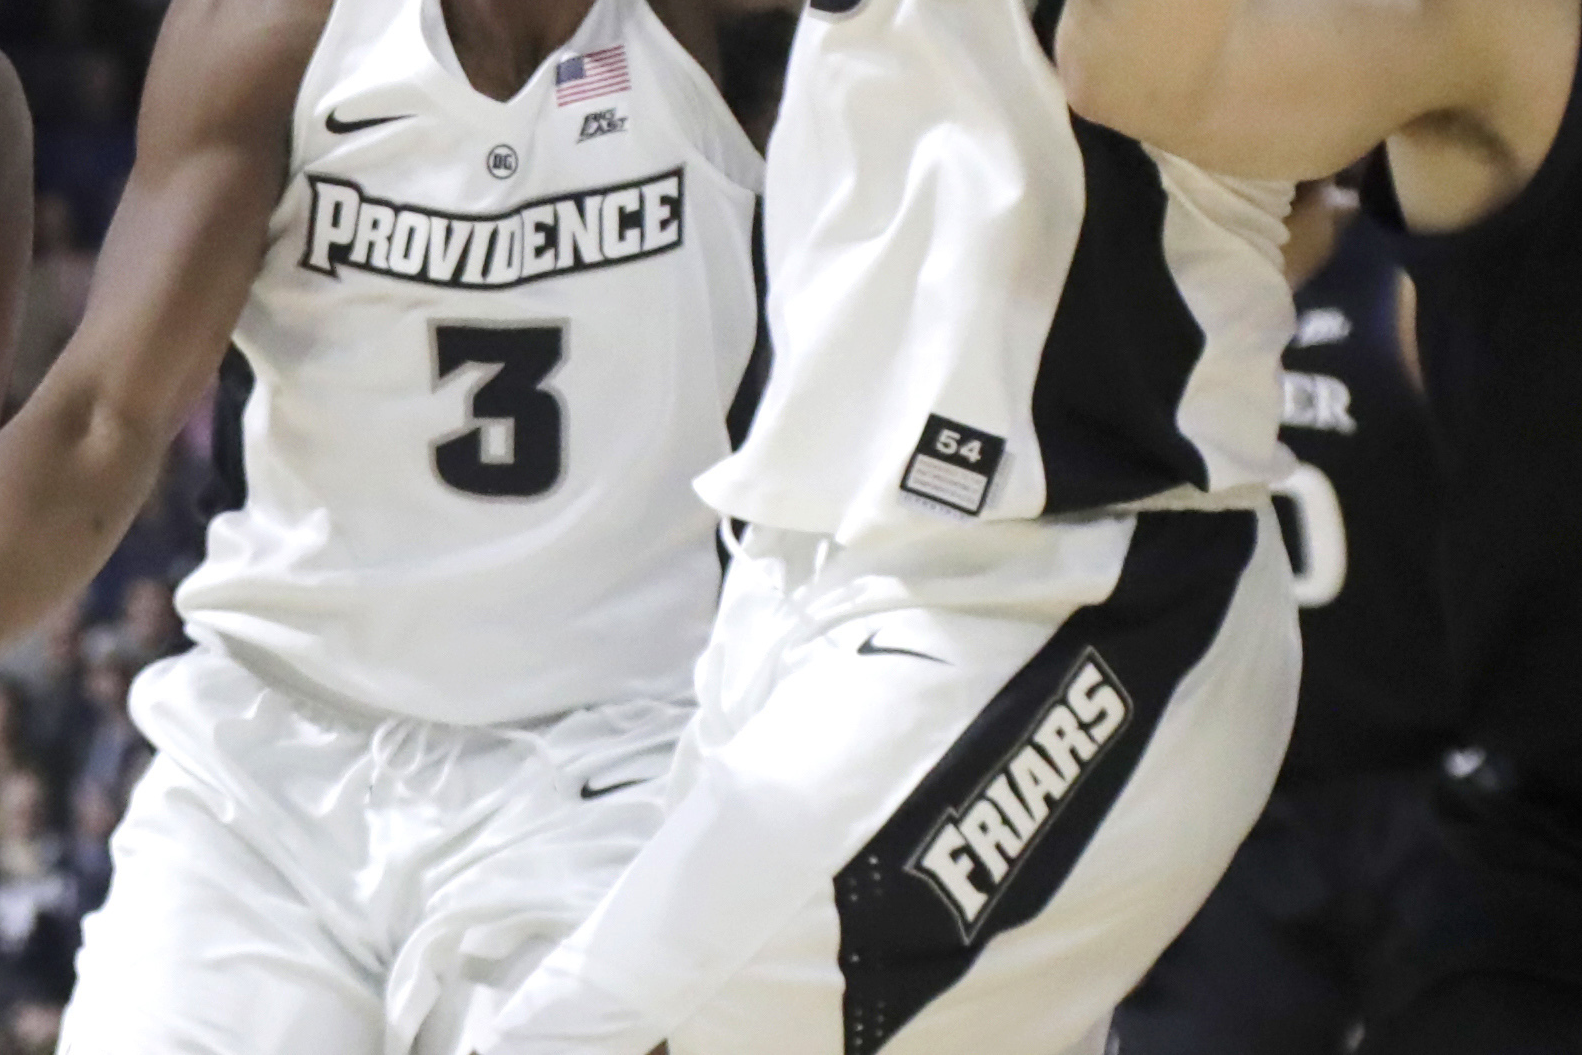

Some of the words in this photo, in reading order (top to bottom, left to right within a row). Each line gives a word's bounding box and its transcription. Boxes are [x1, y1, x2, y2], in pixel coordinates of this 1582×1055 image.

[312, 176, 681, 286] PROVIDENCE
[428, 318, 570, 502] 3
[936, 428, 983, 463] 54
[921, 662, 1126, 923] FRIARS
